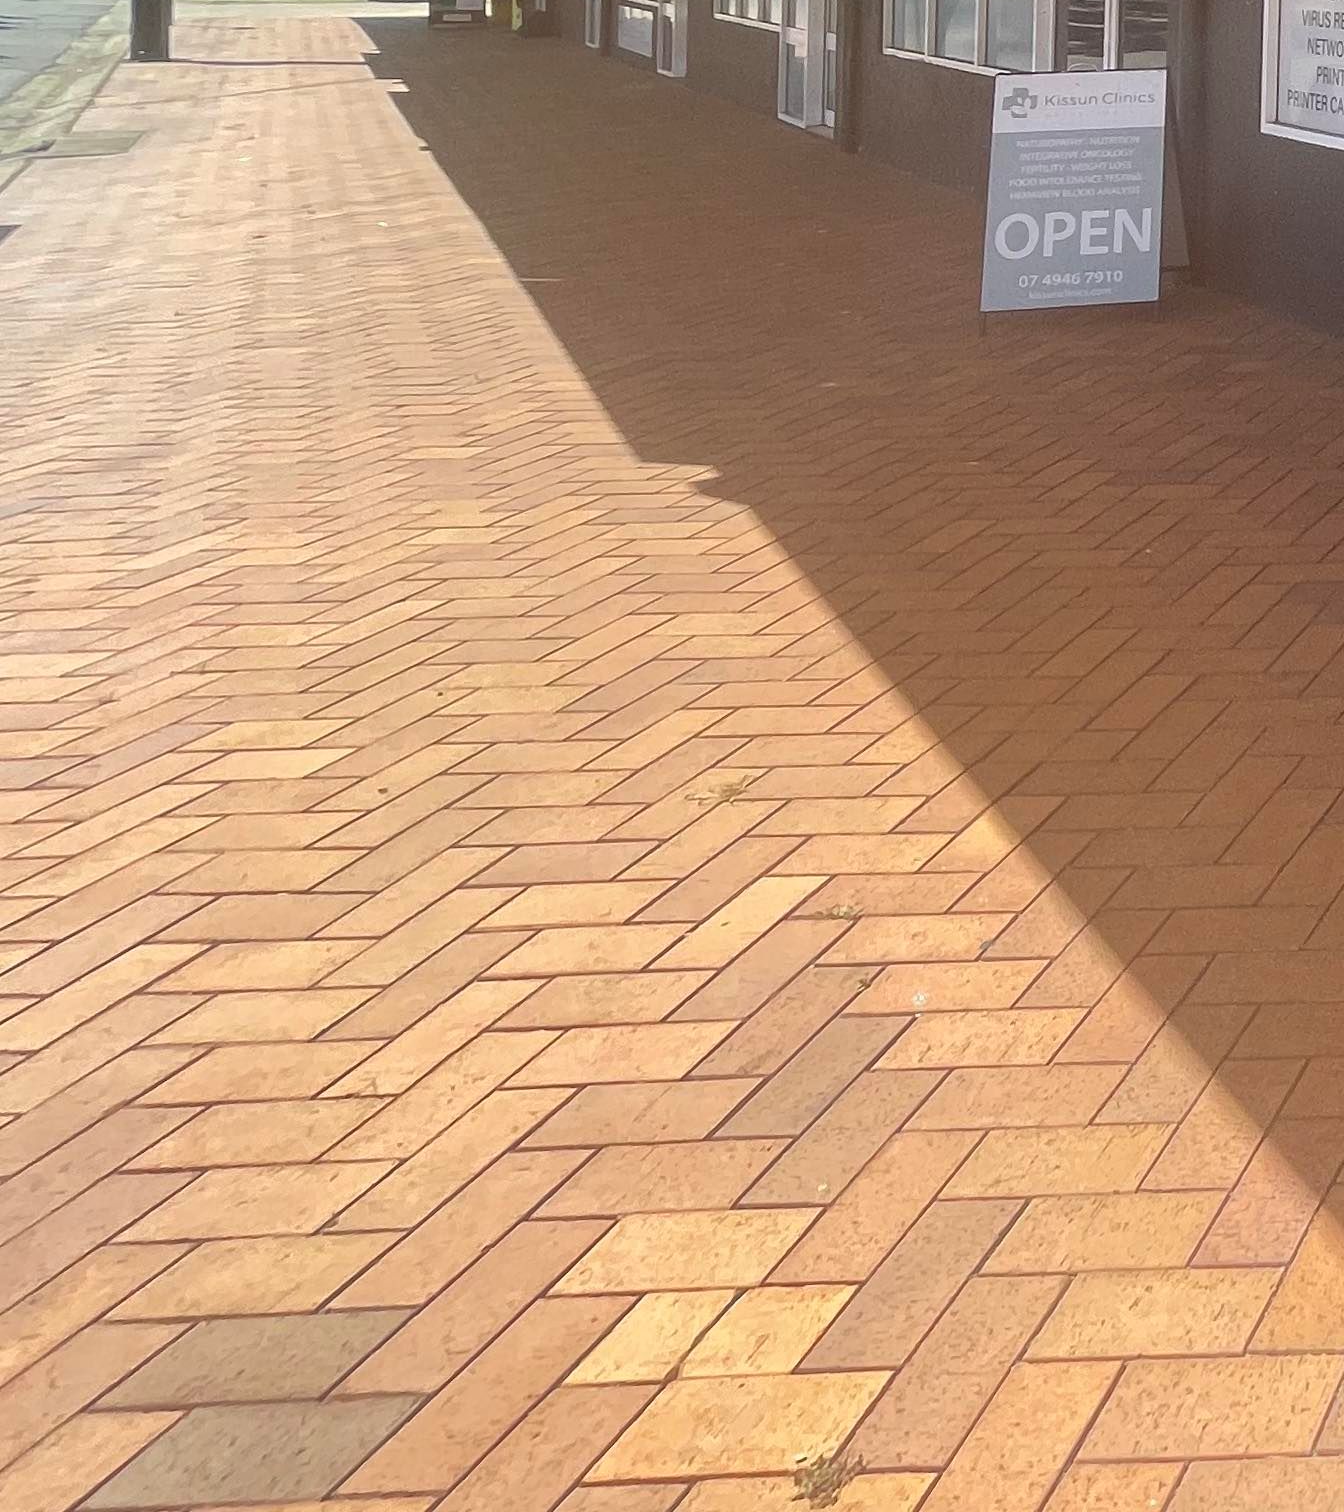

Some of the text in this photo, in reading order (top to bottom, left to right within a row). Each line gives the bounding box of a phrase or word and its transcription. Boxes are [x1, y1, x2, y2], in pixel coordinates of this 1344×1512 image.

[1302, 9, 1331, 28] VIRUS
[1044, 91, 1156, 107] Kissun Clinics
[1287, 89, 1328, 111] PRINTER
[995, 207, 1152, 260] OPEN
[1018, 270, 1124, 288] 07 4946 7910
